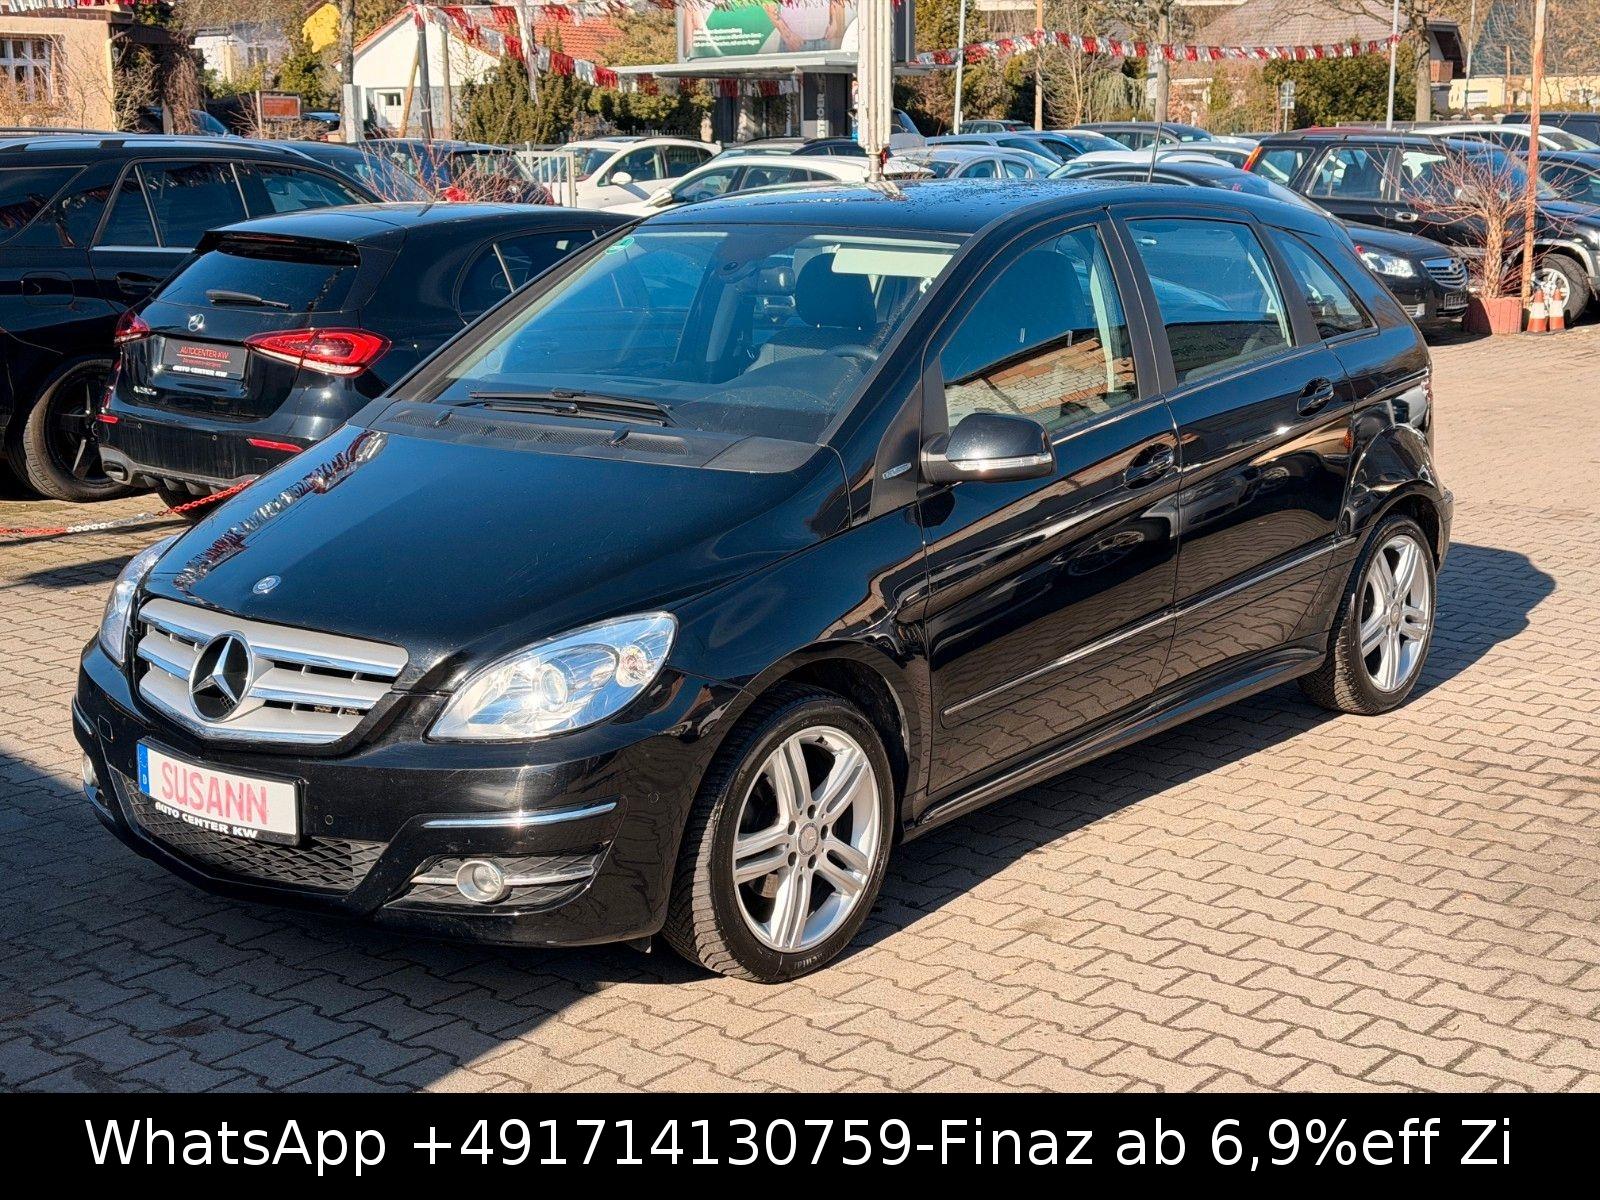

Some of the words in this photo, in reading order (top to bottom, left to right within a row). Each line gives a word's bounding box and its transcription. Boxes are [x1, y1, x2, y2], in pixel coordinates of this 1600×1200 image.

[142, 774, 147, 785] D
[162, 762, 267, 825] SUSANN
[155, 802, 180, 818] AUTO
[182, 812, 229, 834] CENTER
[232, 827, 258, 839] KW
